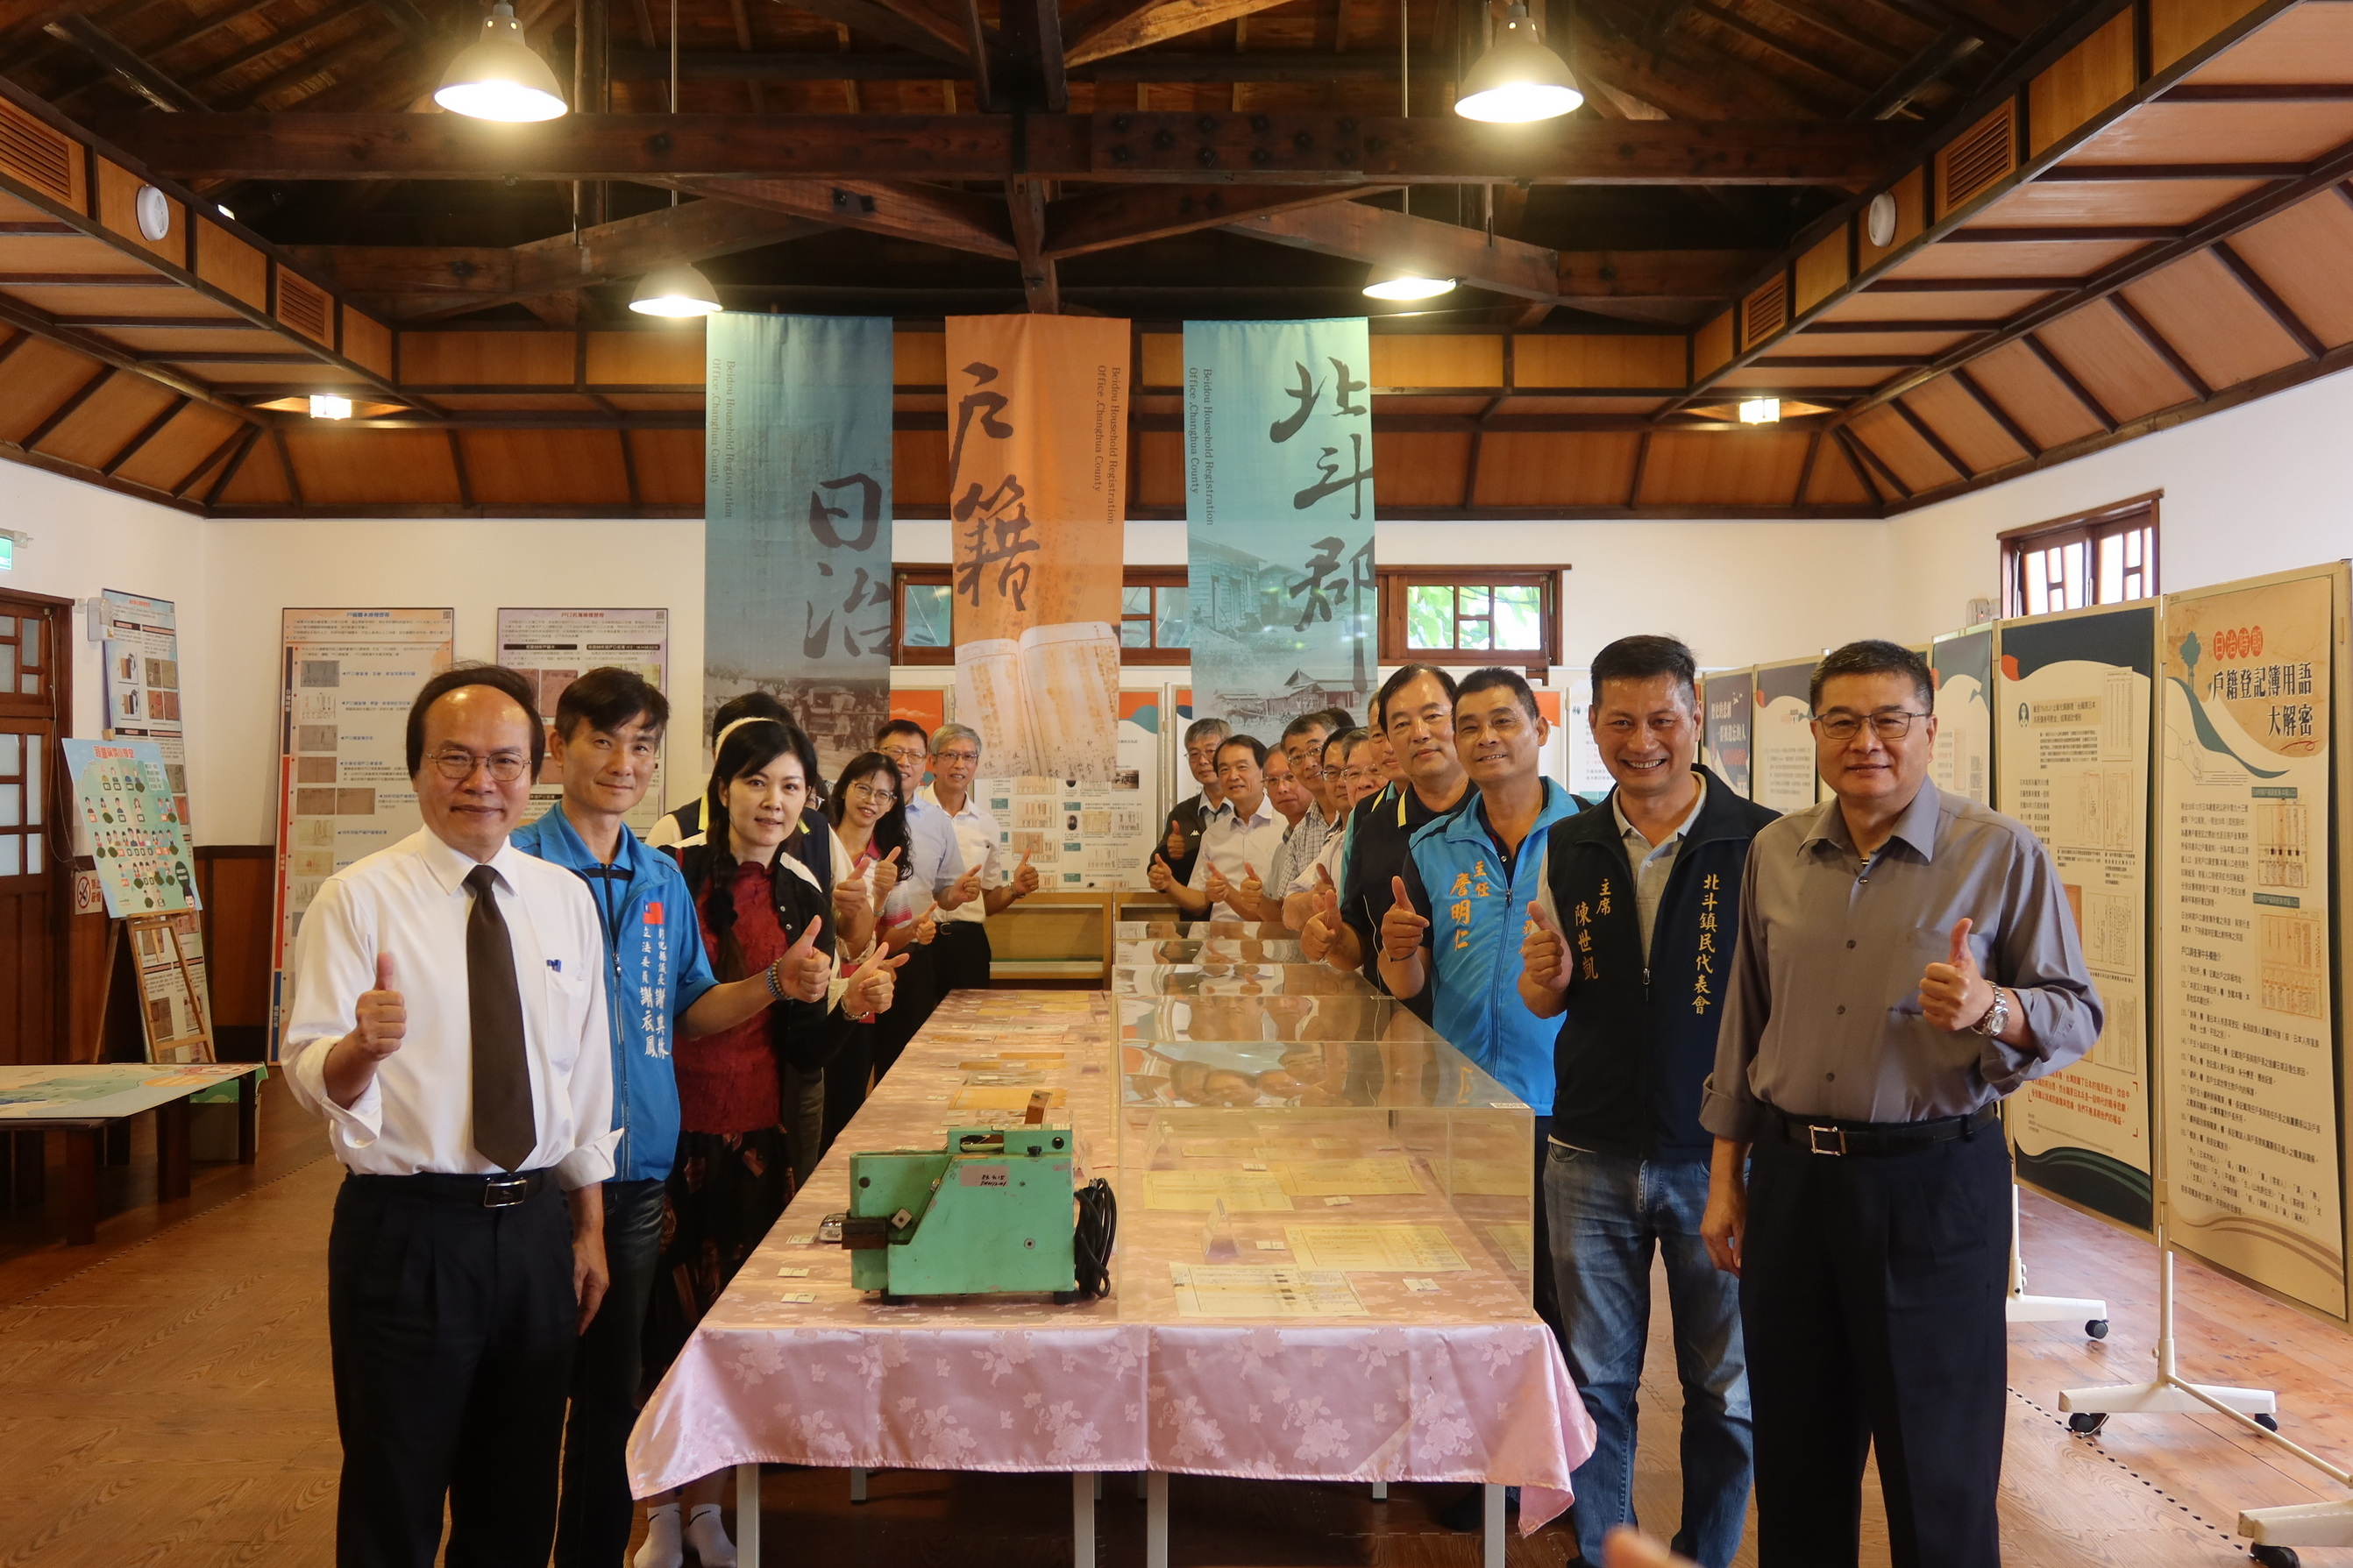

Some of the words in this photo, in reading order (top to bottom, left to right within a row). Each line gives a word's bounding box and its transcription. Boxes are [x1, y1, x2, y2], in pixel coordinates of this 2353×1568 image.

[712, 358, 721, 390] Office
[726, 360, 736, 394] Beidou
[1098, 365, 1106, 397] Office
[1111, 367, 1120, 401] Beidou
[1189, 367, 1198, 399] Office
[1203, 368, 1212, 403] Beidou
[725, 399, 735, 450] Household
[1109, 405, 1120, 457] Household
[1204, 407, 1213, 458] Household
[709, 449, 720, 483] County
[1092, 456, 1103, 492] County
[1191, 458, 1200, 493] County
[723, 453, 735, 518] Registration
[949, 360, 1041, 613] 戶籍
[1107, 461, 1118, 524] Registration
[1204, 461, 1215, 526] Registration
[1269, 356, 1375, 692] 北斗郡
[2214, 627, 2263, 659] 日治時期
[2213, 662, 2313, 701] 戶籍登記簿用語
[2267, 704, 2313, 739] 大解密
[1473, 860, 1490, 898] 主任
[1596, 878, 1612, 916] 主席
[1449, 872, 1471, 952] 詹明仁
[1575, 901, 1599, 981] 陳世凱
[1691, 874, 1719, 1016] 北斗鎮民代表會
[640, 926, 658, 1058] 立法委員謝衣鳳
